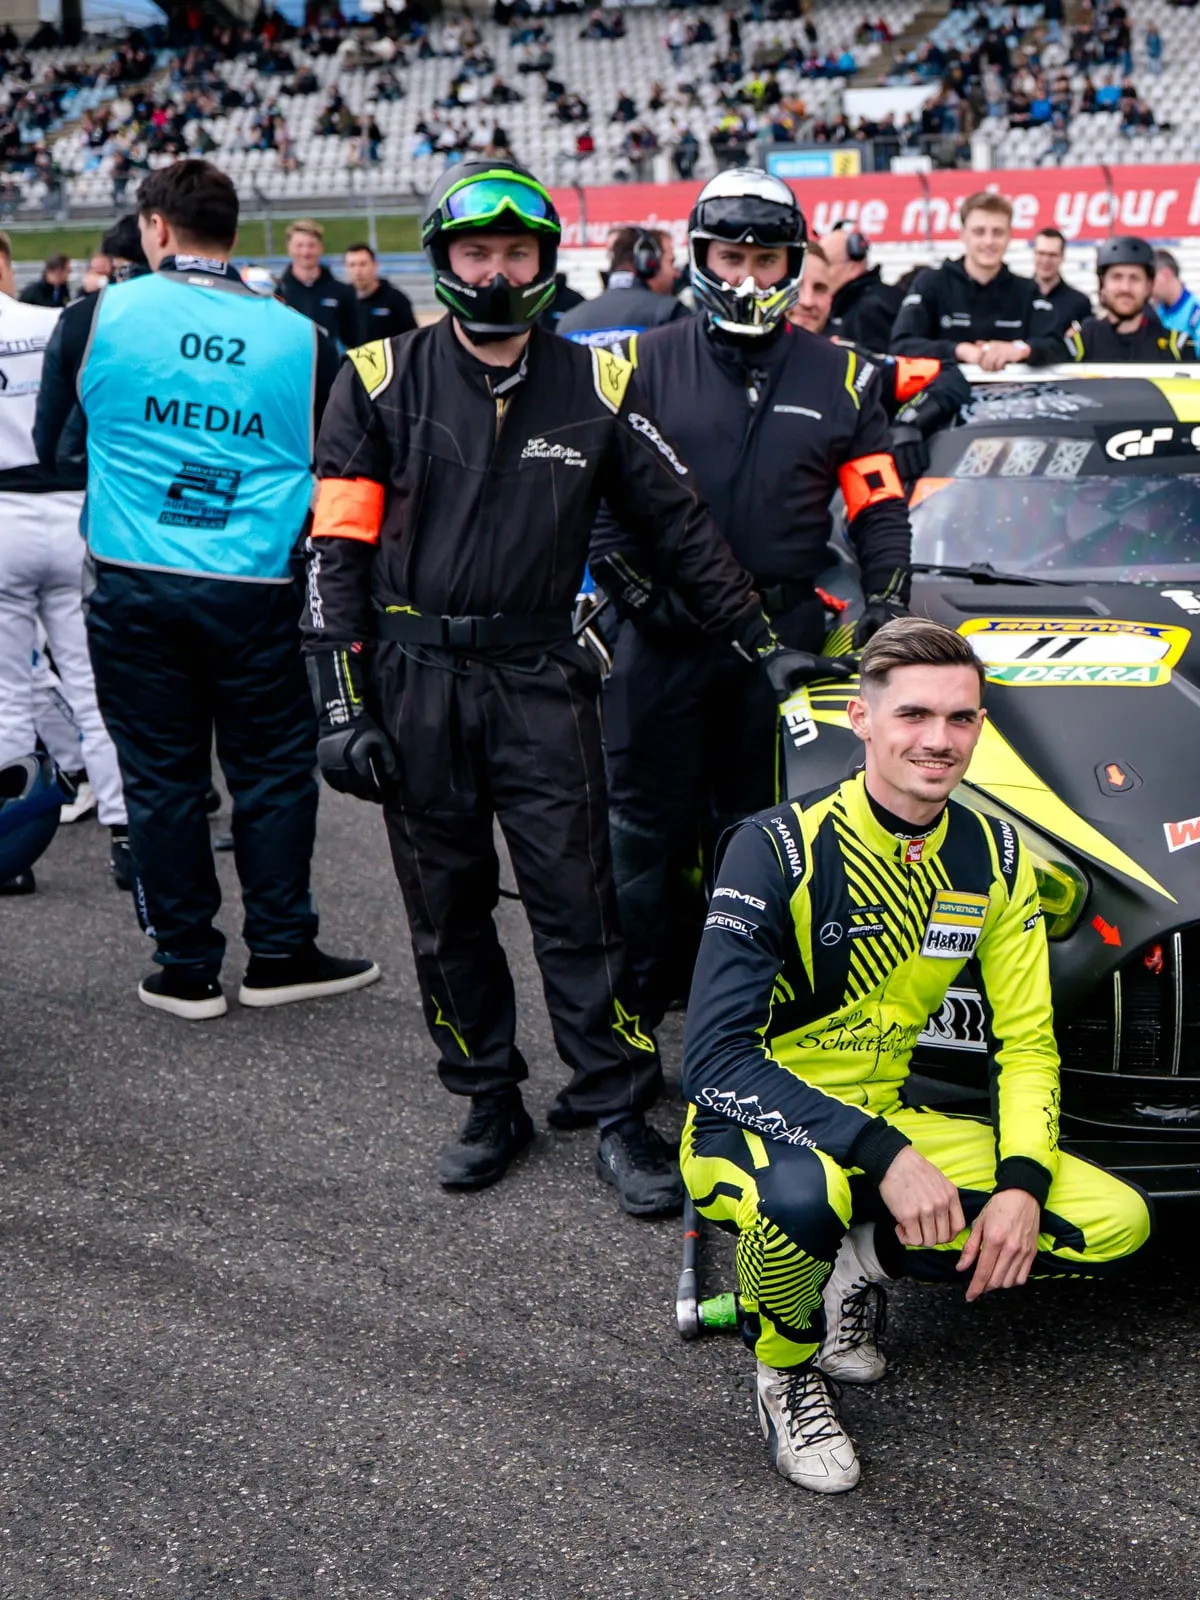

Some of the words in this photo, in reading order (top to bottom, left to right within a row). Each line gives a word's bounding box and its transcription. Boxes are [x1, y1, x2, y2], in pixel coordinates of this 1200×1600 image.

[814, 199, 888, 235] we
[1054, 191, 1178, 241] your
[179, 332, 247, 366] 062
[144, 395, 265, 440] MEDIA
[995, 622, 1151, 635] RAVENOL
[1016, 636, 1089, 659] 11
[1014, 667, 1150, 681] DEKRA
[770, 816, 803, 878] MARINA
[720, 888, 767, 911] AMG
[939, 904, 980, 914] RAVENOL
[927, 930, 957, 951] H&R
[827, 1010, 863, 1027] Team
[695, 1088, 781, 1134] Schnitzel
[773, 1126, 817, 1149] Alm
